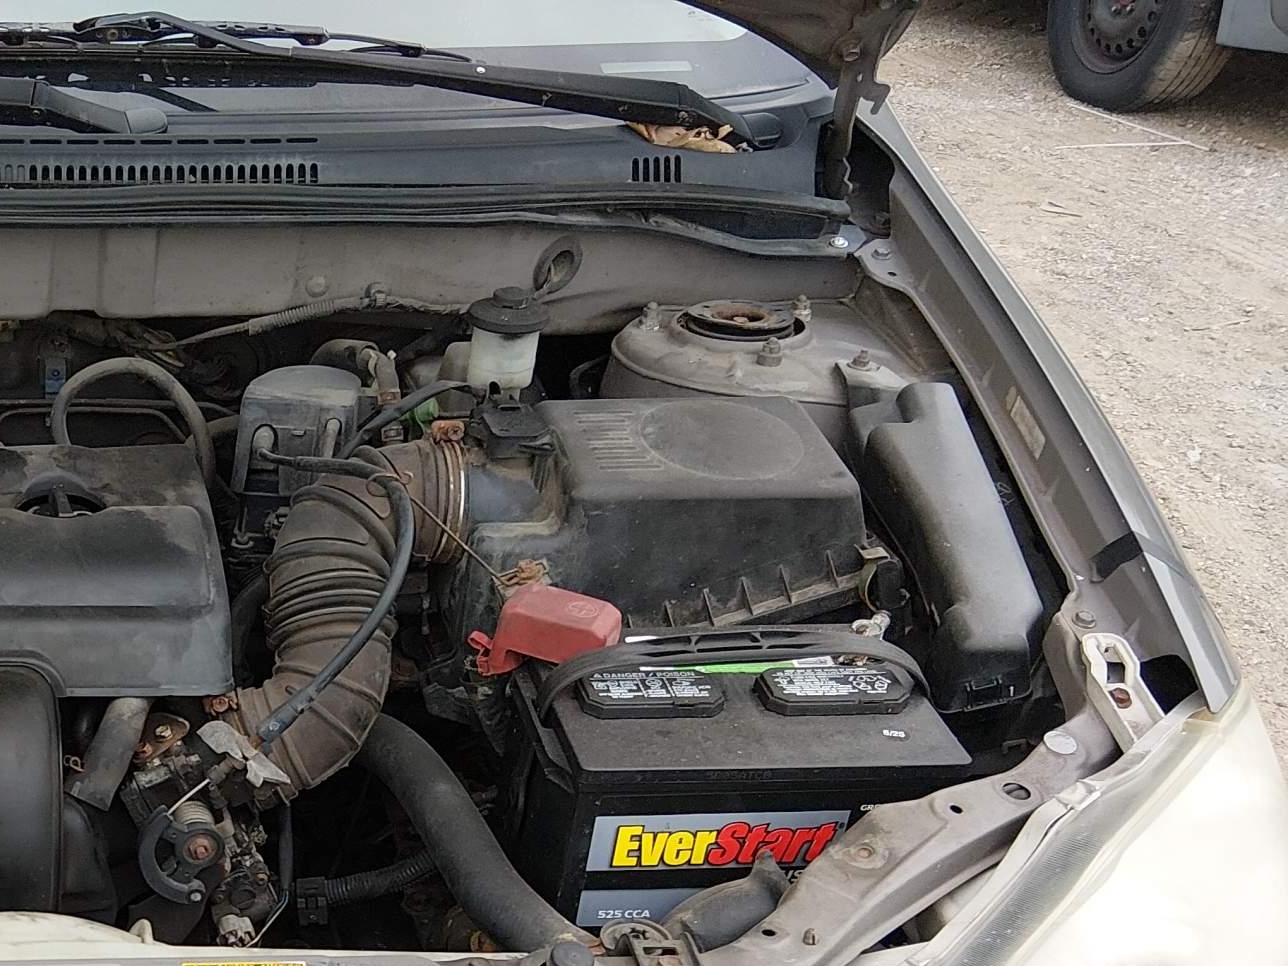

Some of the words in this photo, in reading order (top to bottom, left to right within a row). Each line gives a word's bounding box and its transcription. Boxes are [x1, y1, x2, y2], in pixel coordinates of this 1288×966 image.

[611, 821, 839, 868] EverStart
[597, 909, 624, 919] 525
[624, 909, 651, 919] CCA
